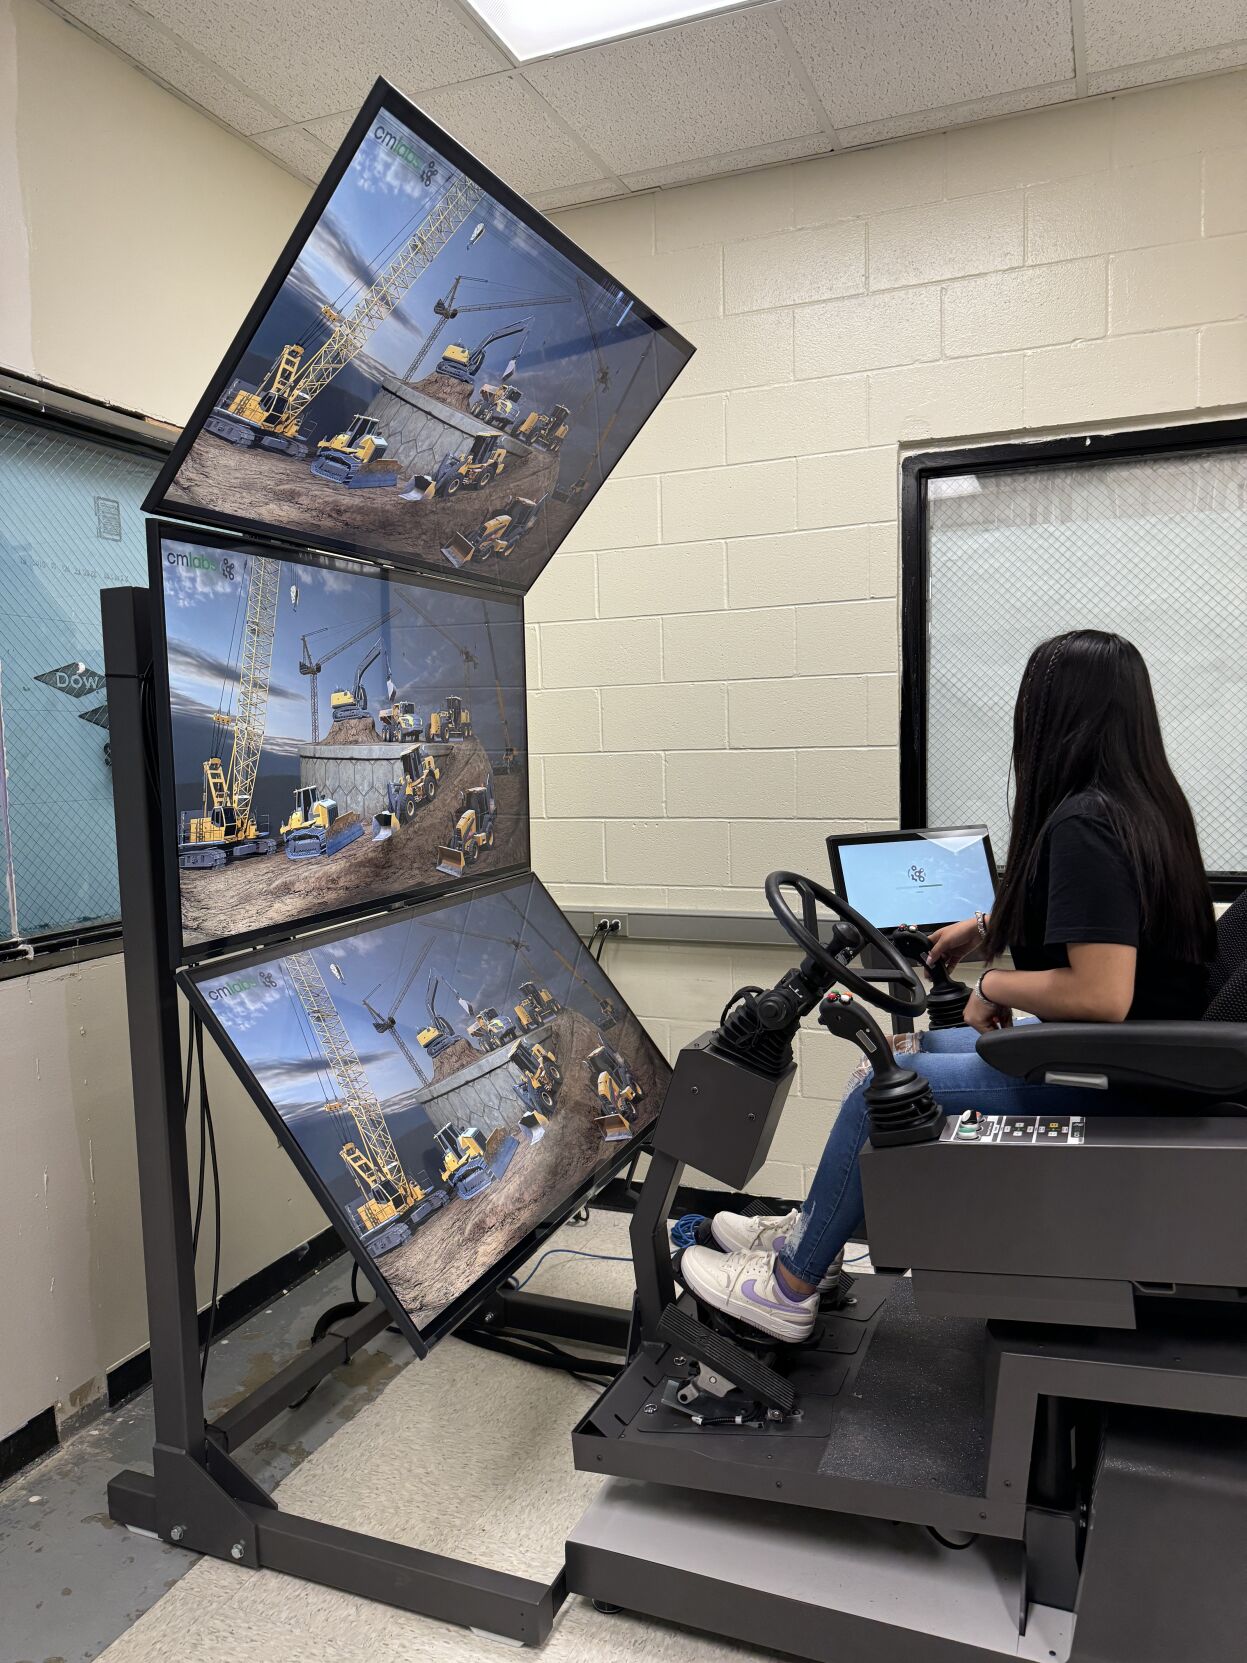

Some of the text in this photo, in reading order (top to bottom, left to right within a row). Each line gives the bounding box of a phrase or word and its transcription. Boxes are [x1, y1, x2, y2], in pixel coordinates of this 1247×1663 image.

[374, 126, 424, 170] cmlabs
[167, 552, 217, 572] cmlabs
[209, 977, 257, 1001] cmlabs
